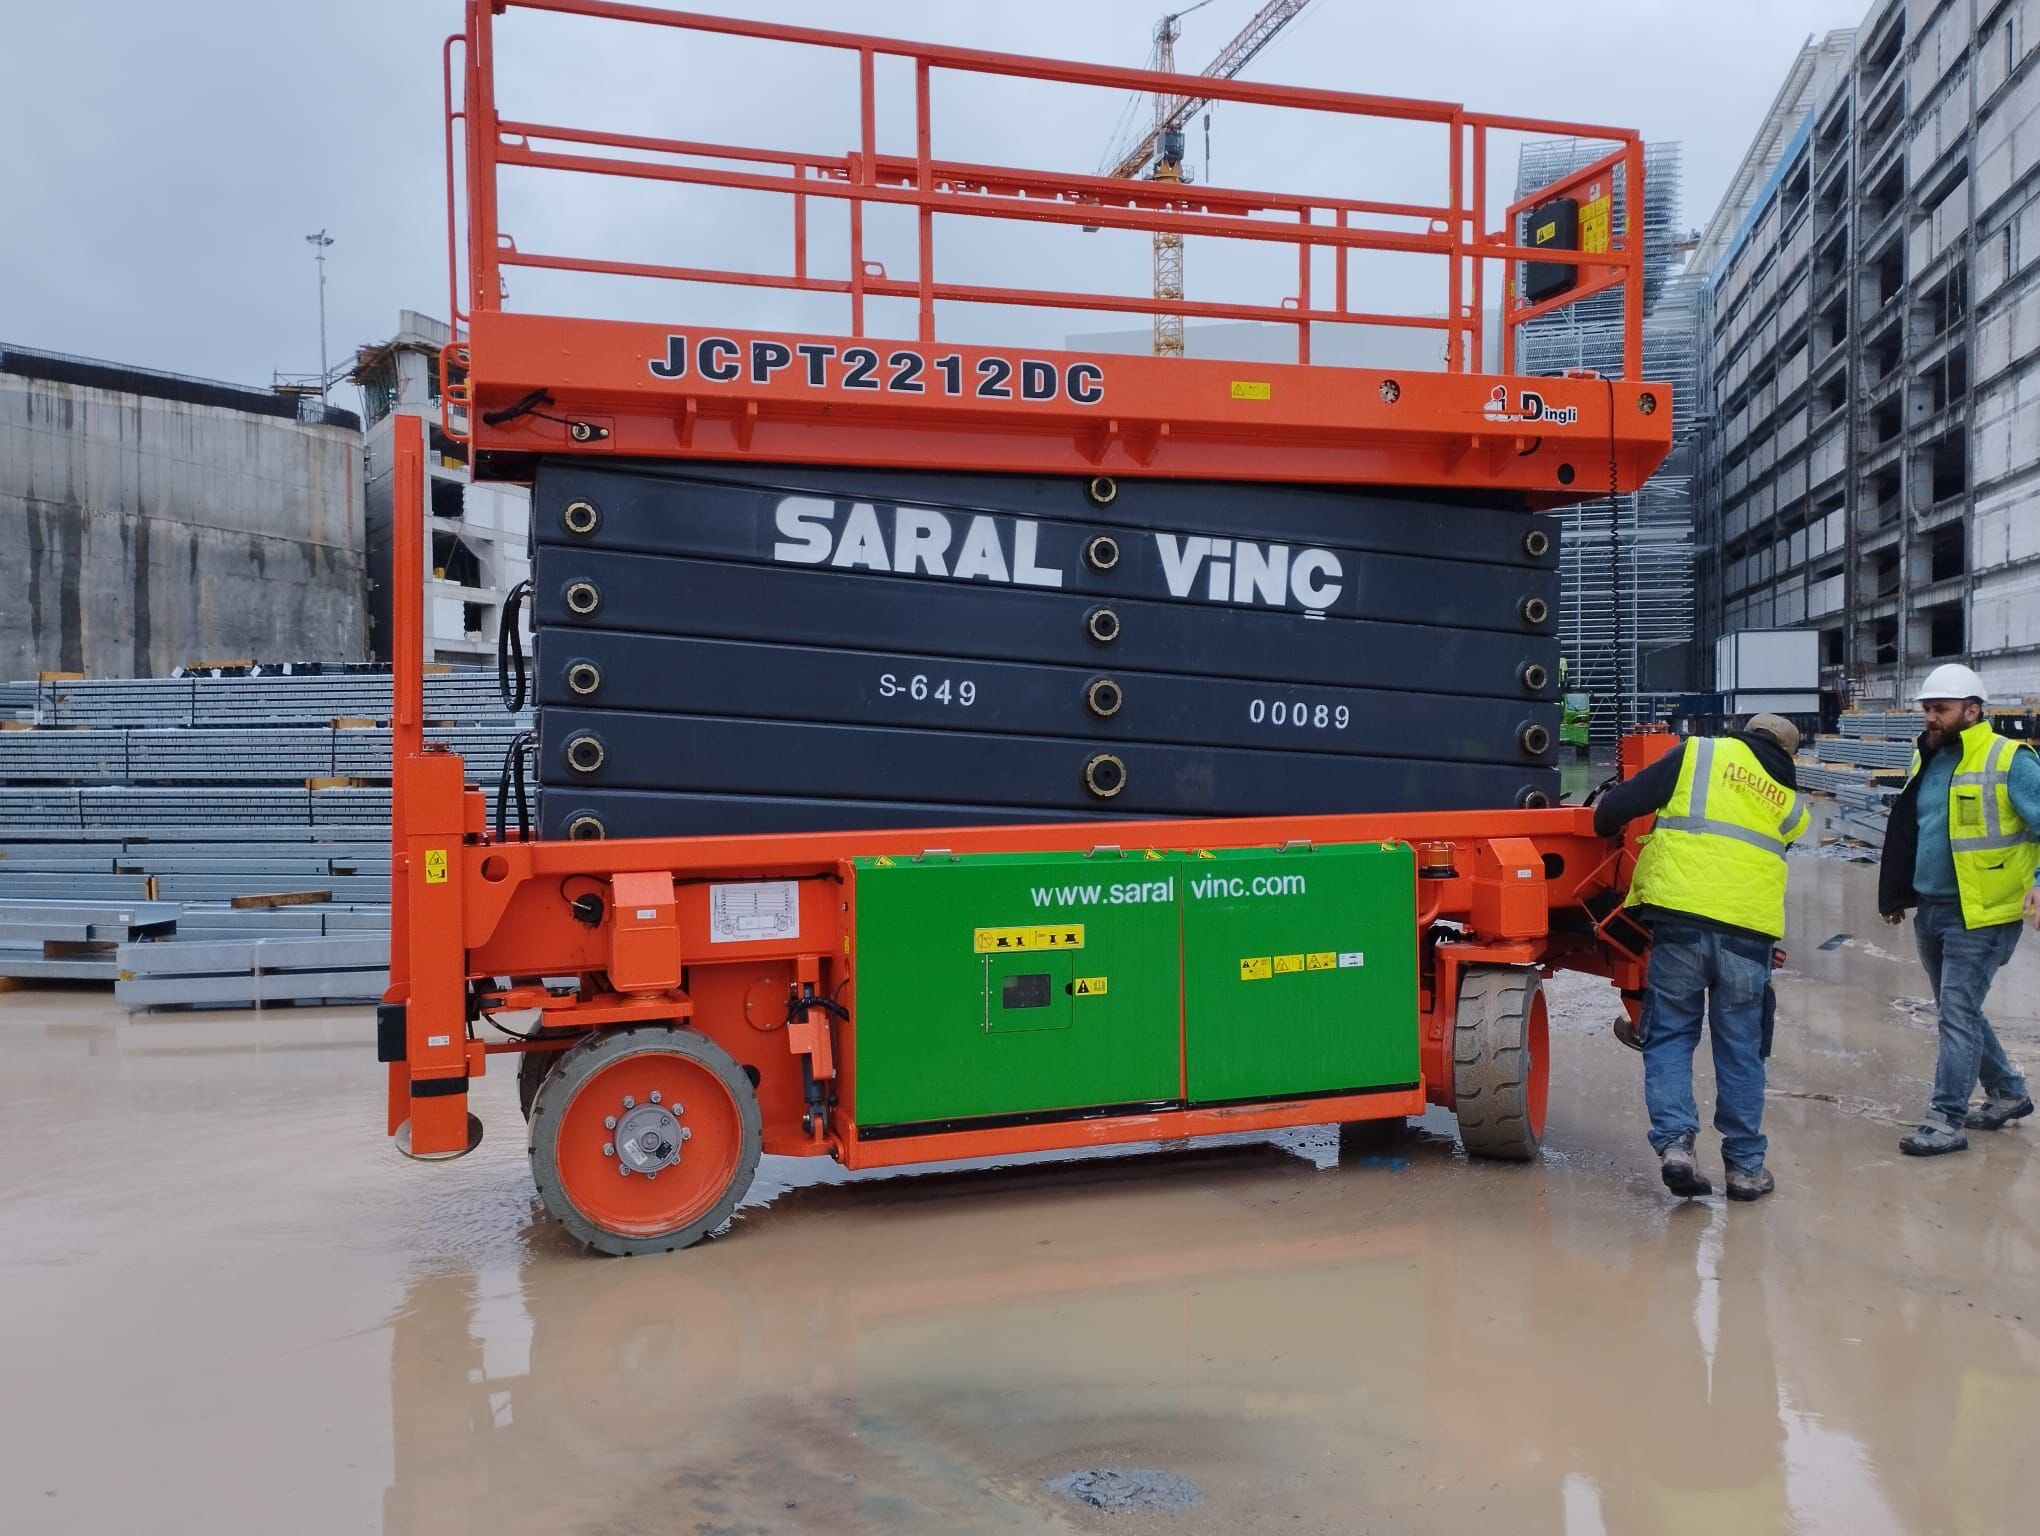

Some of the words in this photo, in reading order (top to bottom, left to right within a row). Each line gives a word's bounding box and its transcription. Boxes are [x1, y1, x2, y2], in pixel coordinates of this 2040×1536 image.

[650, 335, 1104, 404] JCPT2212DC
[1521, 391, 1577, 425] Dingli
[774, 496, 1063, 588] SARAL
[879, 673, 977, 706] S-649
[1249, 699, 1350, 730] 00089
[1722, 762, 1787, 806] ACCURO
[1030, 876, 1174, 907] www.saral
[1191, 873, 1305, 899] vinc.com
